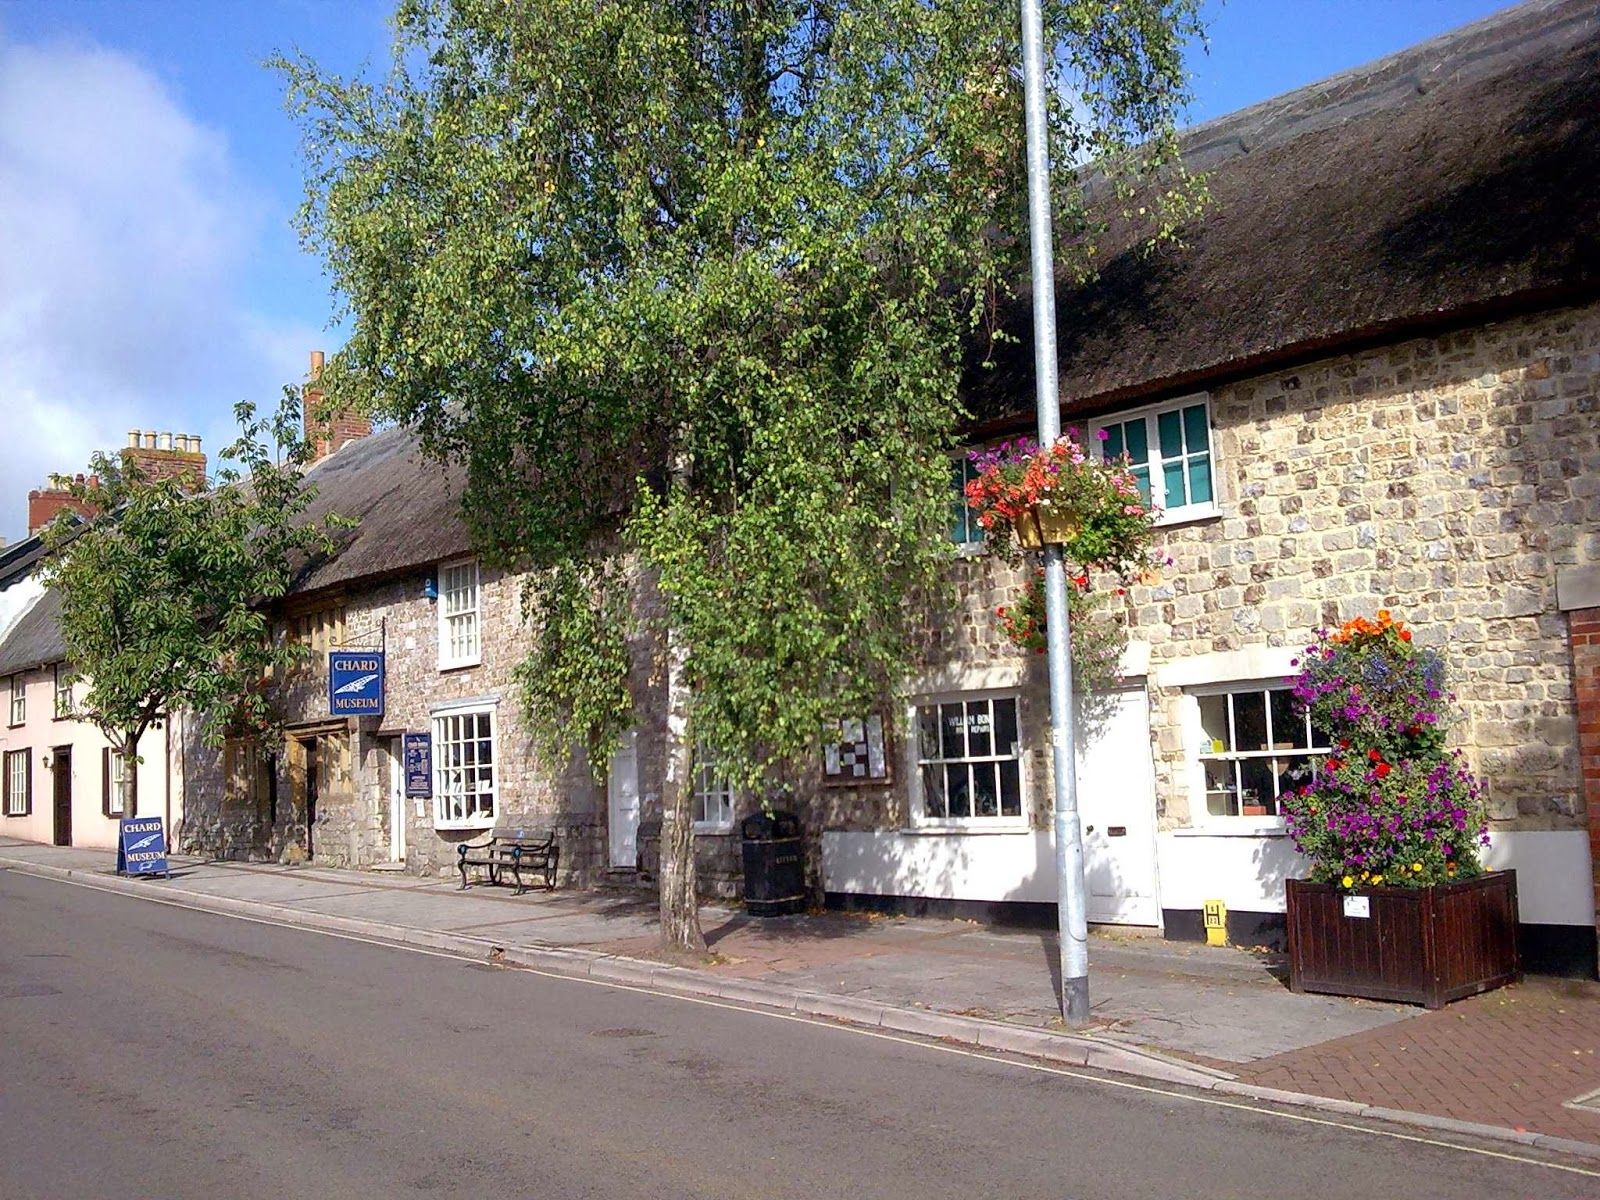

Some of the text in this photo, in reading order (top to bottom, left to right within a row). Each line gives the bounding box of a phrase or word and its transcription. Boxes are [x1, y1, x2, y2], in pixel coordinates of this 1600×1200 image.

[334, 660, 378, 671] CHARD
[335, 698, 379, 709] MUSEUM
[124, 822, 161, 833] CHARD
[127, 851, 166, 862] MUSEUM
